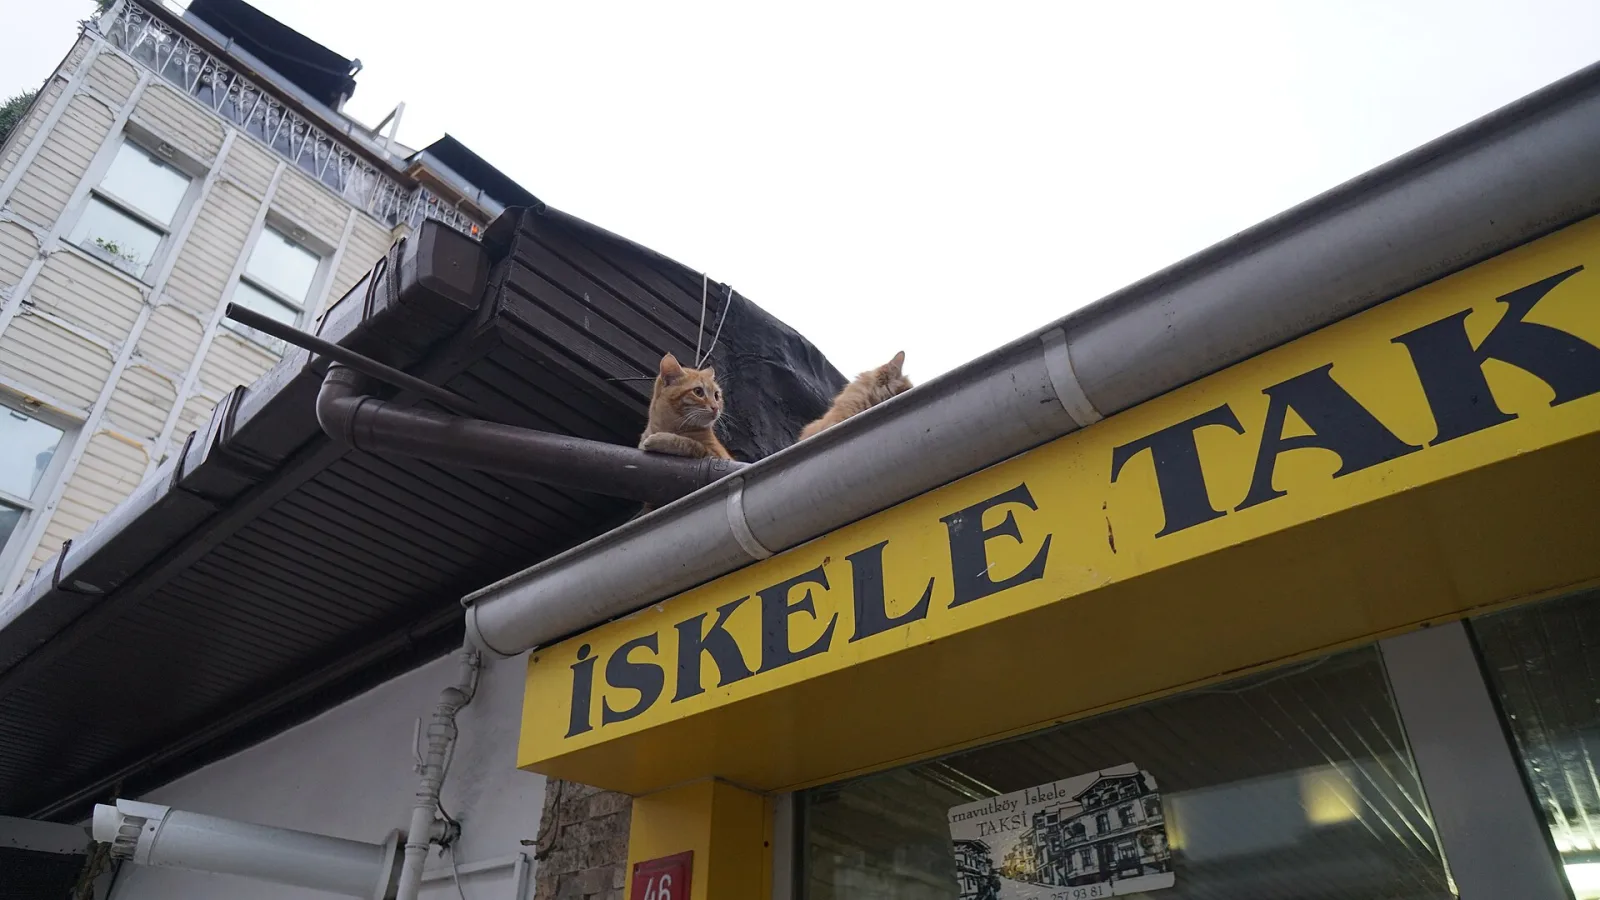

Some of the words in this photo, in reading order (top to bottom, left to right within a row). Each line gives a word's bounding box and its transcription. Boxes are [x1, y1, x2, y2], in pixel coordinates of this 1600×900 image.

[564, 482, 1052, 739] İSKELE
[1110, 264, 1600, 539] TAK
[948, 797, 1018, 823] rnavutköy
[1024, 783, 1066, 806] İskele
[976, 811, 1028, 837] TAKSİ
[644, 874, 672, 900] 46
[1073, 888, 1087, 900] 93
[1090, 885, 1103, 898] 81
